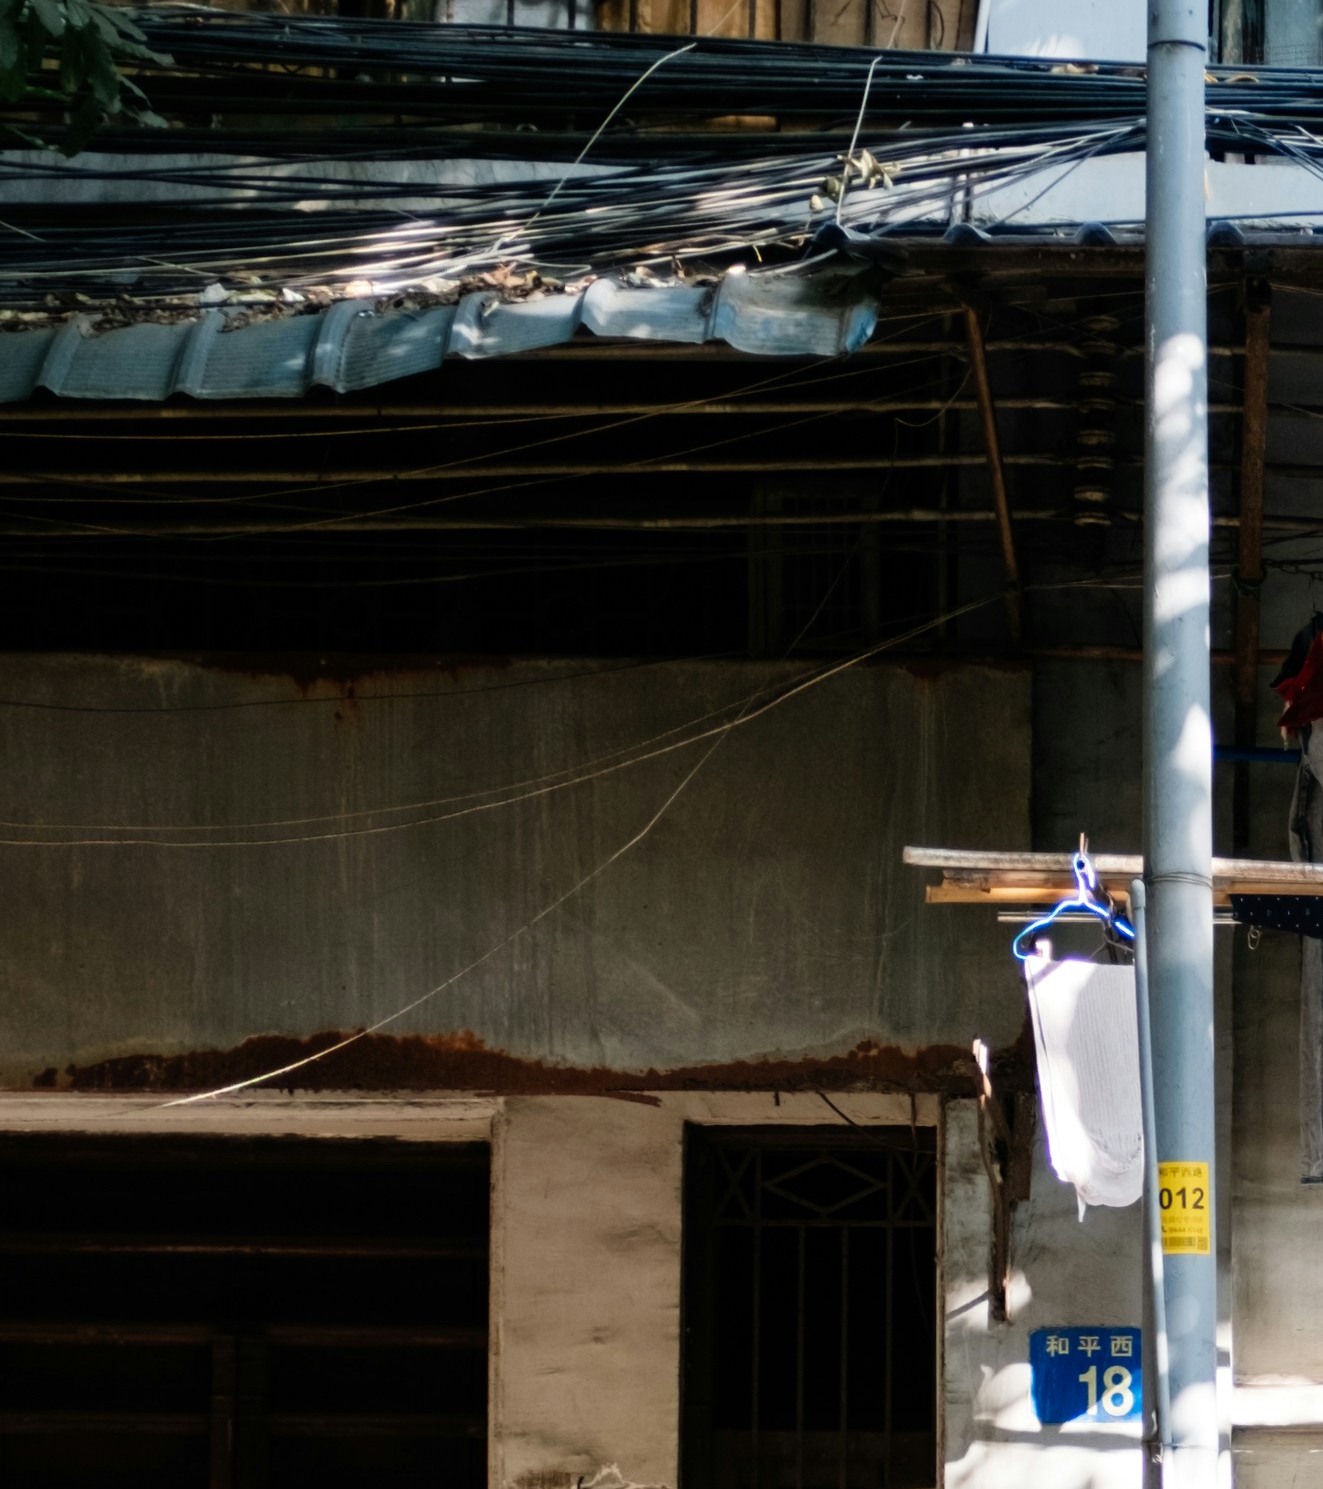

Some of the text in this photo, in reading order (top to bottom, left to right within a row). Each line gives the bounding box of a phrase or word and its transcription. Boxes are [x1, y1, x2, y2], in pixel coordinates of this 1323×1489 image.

[1046, 1335, 1133, 1358] 和平西
[1078, 1365, 1134, 1417] 18
